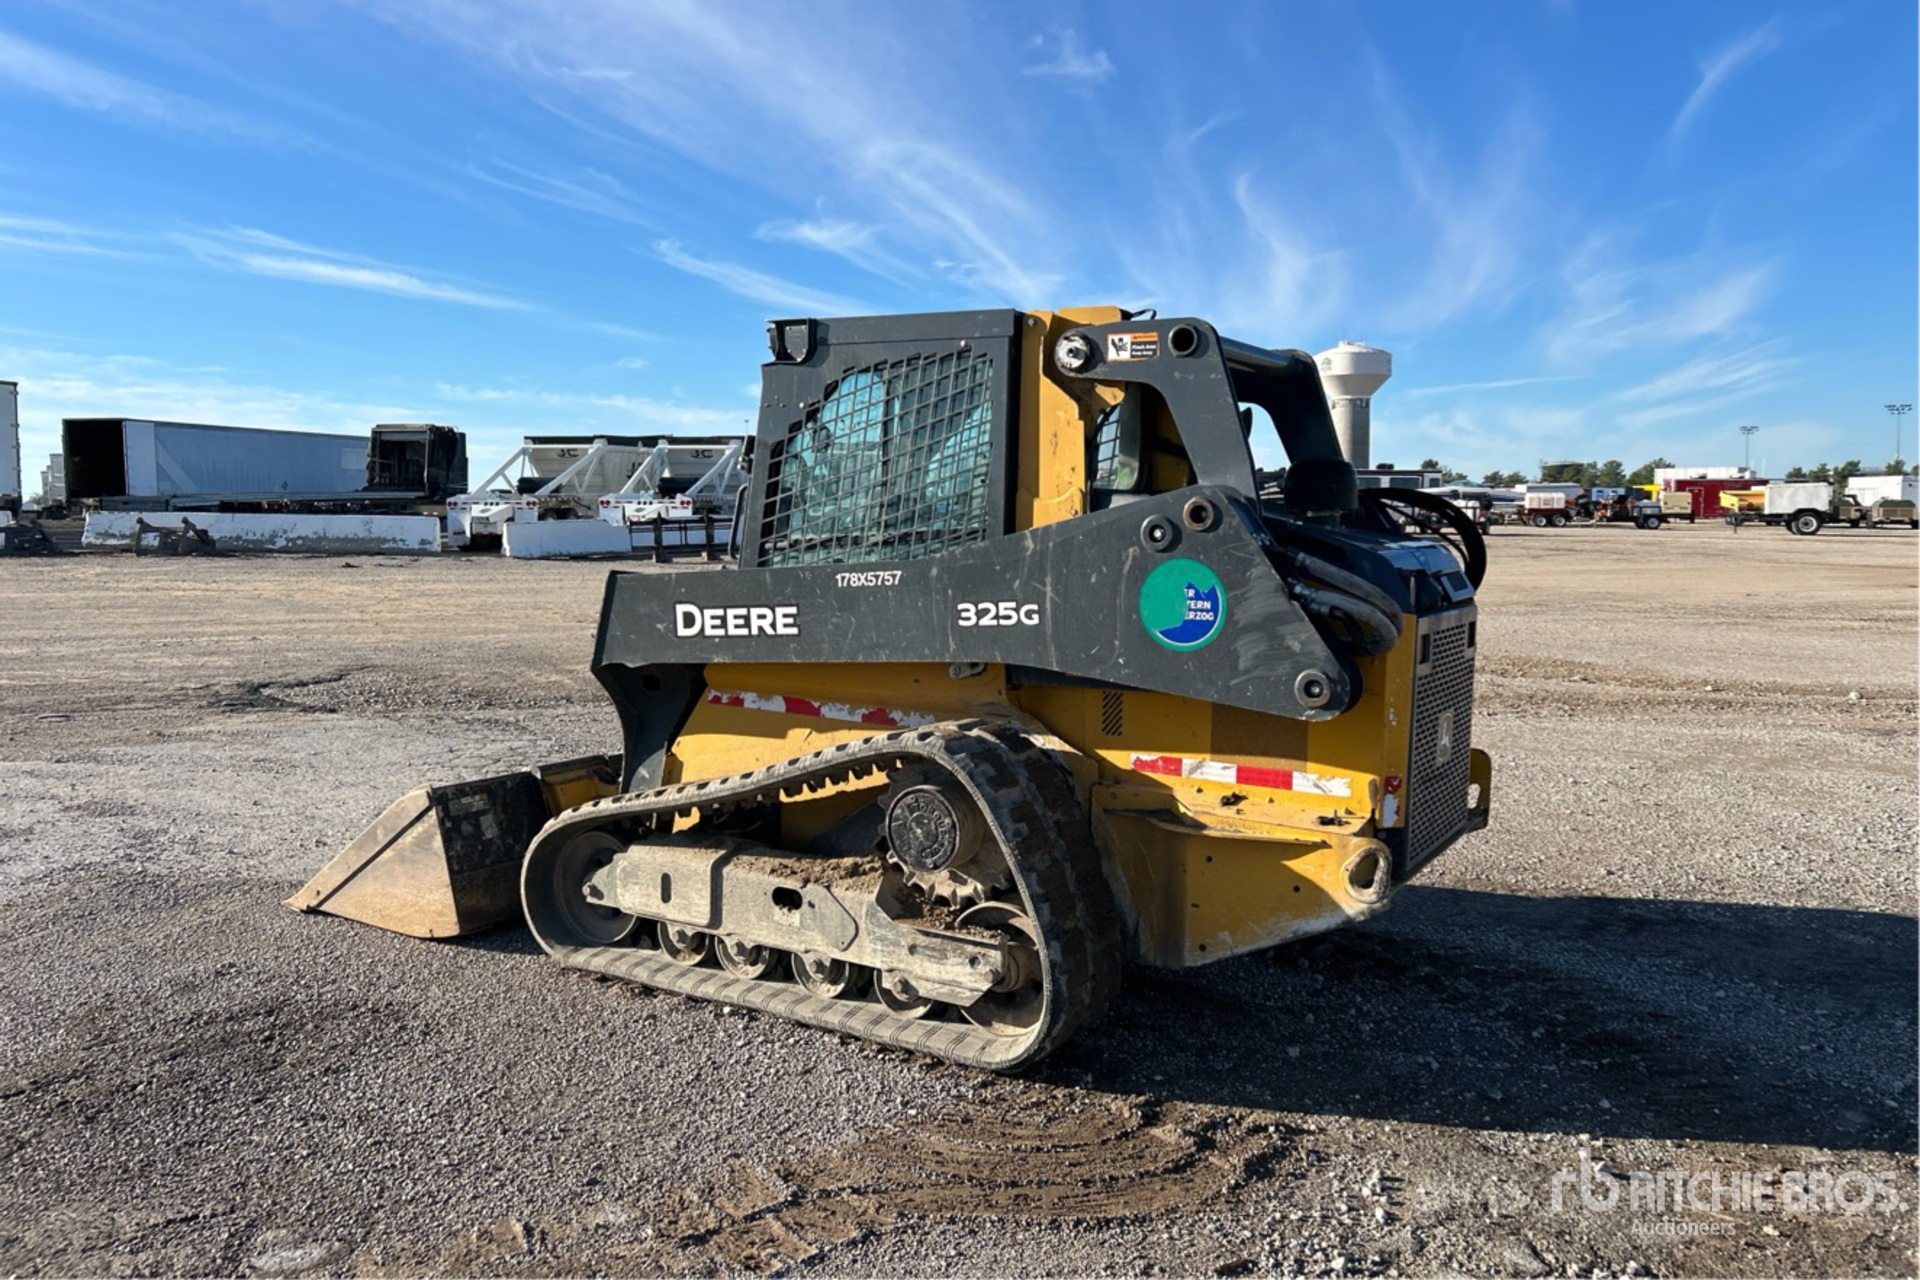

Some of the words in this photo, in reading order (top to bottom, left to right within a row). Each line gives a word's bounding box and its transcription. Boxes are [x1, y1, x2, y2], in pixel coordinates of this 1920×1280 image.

[835, 570, 902, 587] 178X5757
[675, 603, 799, 637] DEERE
[957, 602, 1040, 627] 325G
